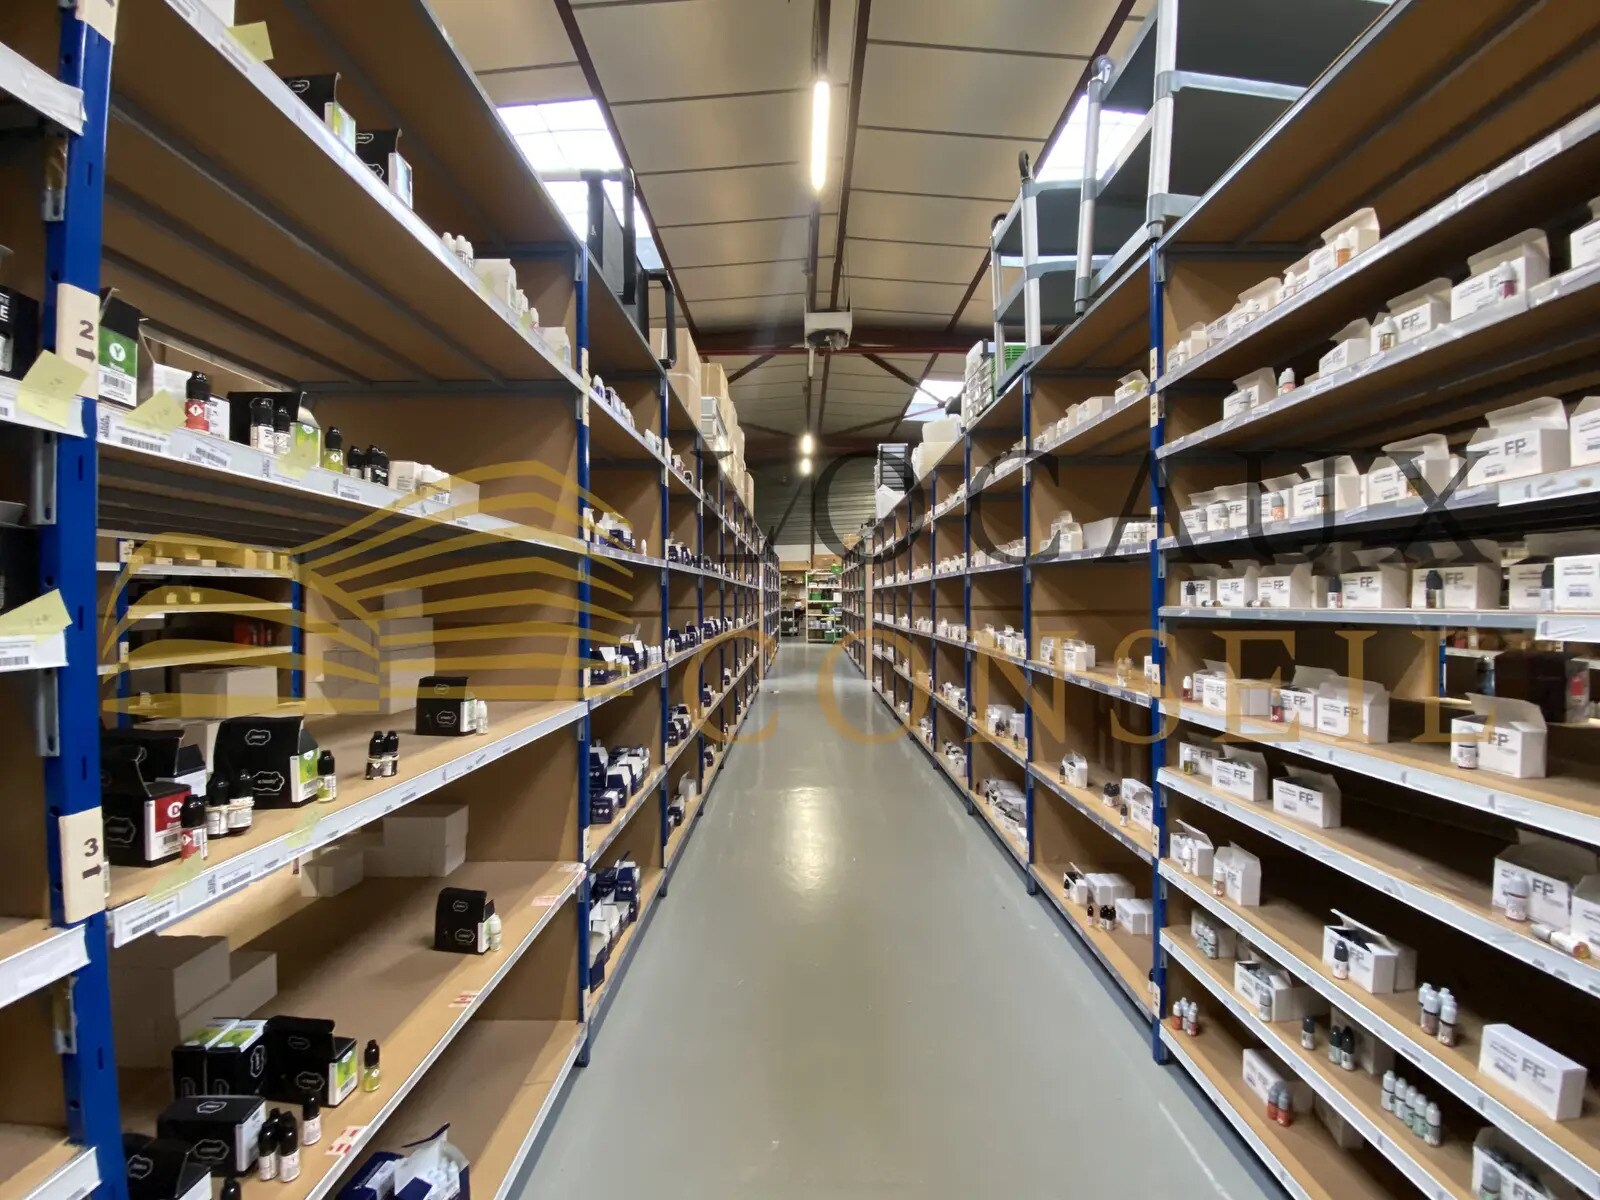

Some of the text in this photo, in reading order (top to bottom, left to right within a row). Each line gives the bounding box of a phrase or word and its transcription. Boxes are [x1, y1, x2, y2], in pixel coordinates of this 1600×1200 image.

[1401, 311, 1420, 331] FP
[79, 319, 94, 341] 2
[1505, 438, 1527, 456] FP
[1229, 504, 1242, 513] FP
[1274, 580, 1284, 590] FP
[1360, 577, 1373, 587] FP
[1445, 572, 1464, 587] FP
[1294, 695, 1306, 705] FP
[1343, 706, 1359, 717] FP
[1488, 733, 1508, 746] FP
[1201, 750, 1212, 760] FP
[1234, 769, 1246, 779] FP
[1299, 791, 1314, 803] FP
[84, 837, 99, 857] 3
[1532, 878, 1554, 896] FP
[1521, 1057, 1546, 1079] FP
